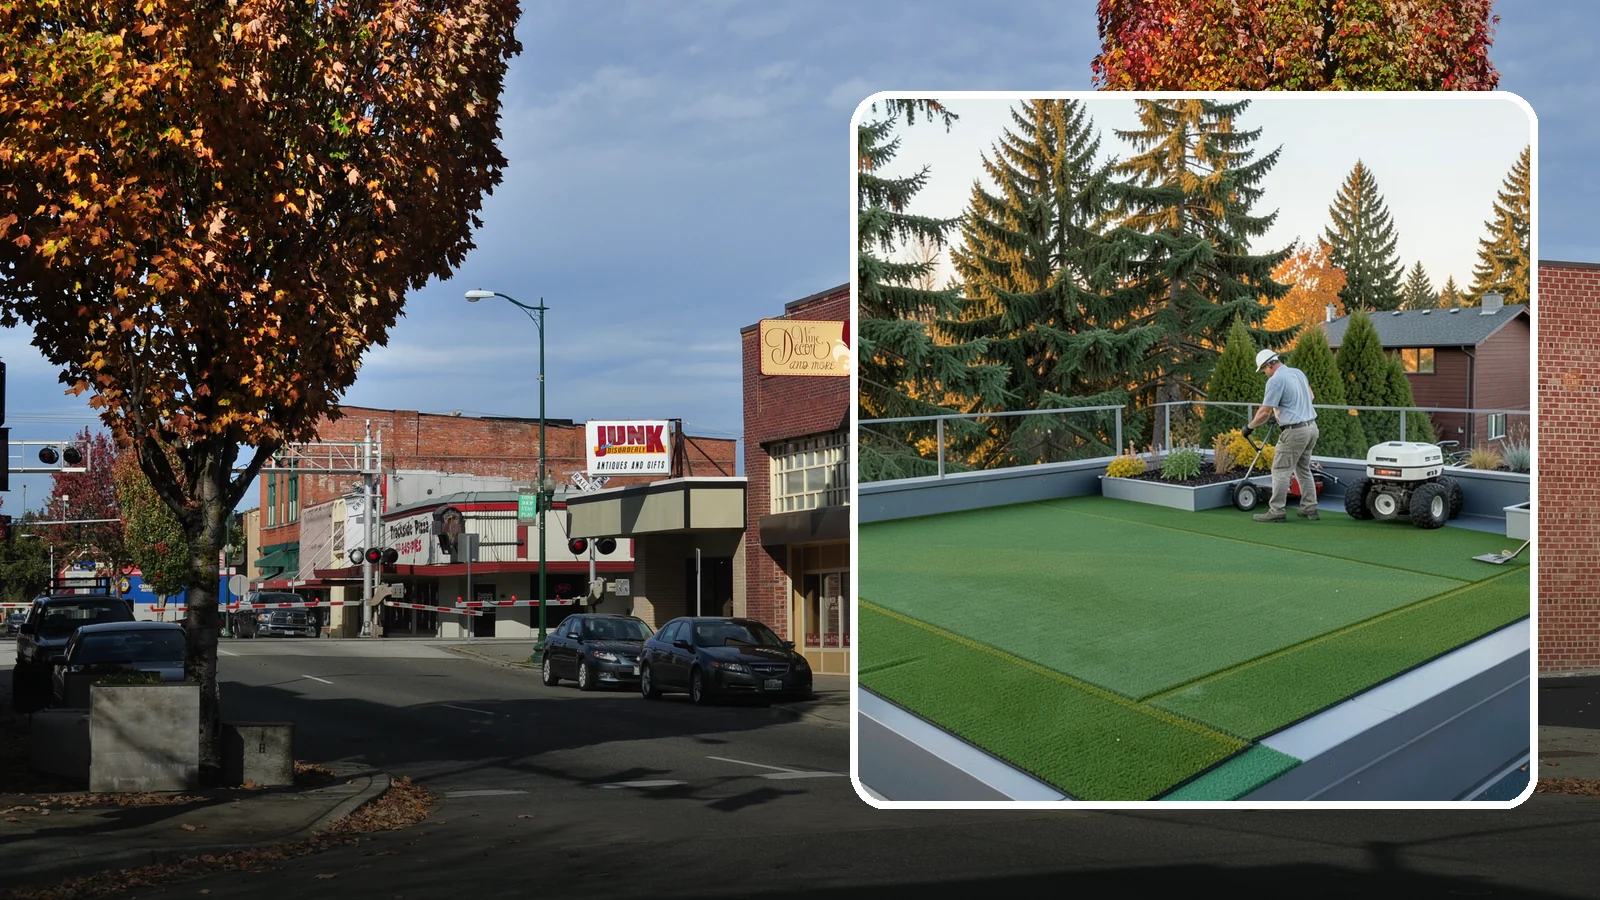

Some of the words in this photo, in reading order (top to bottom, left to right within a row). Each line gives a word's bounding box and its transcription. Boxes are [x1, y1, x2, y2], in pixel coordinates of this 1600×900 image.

[595, 425, 665, 457] JUNK
[607, 446, 646, 454] DISORDERLY
[597, 461, 628, 470] ANTIQUES
[631, 461, 644, 470] AND
[647, 460, 666, 469] GIFTS
[390, 522, 413, 540] Trackside
[414, 519, 429, 535] Pizza
